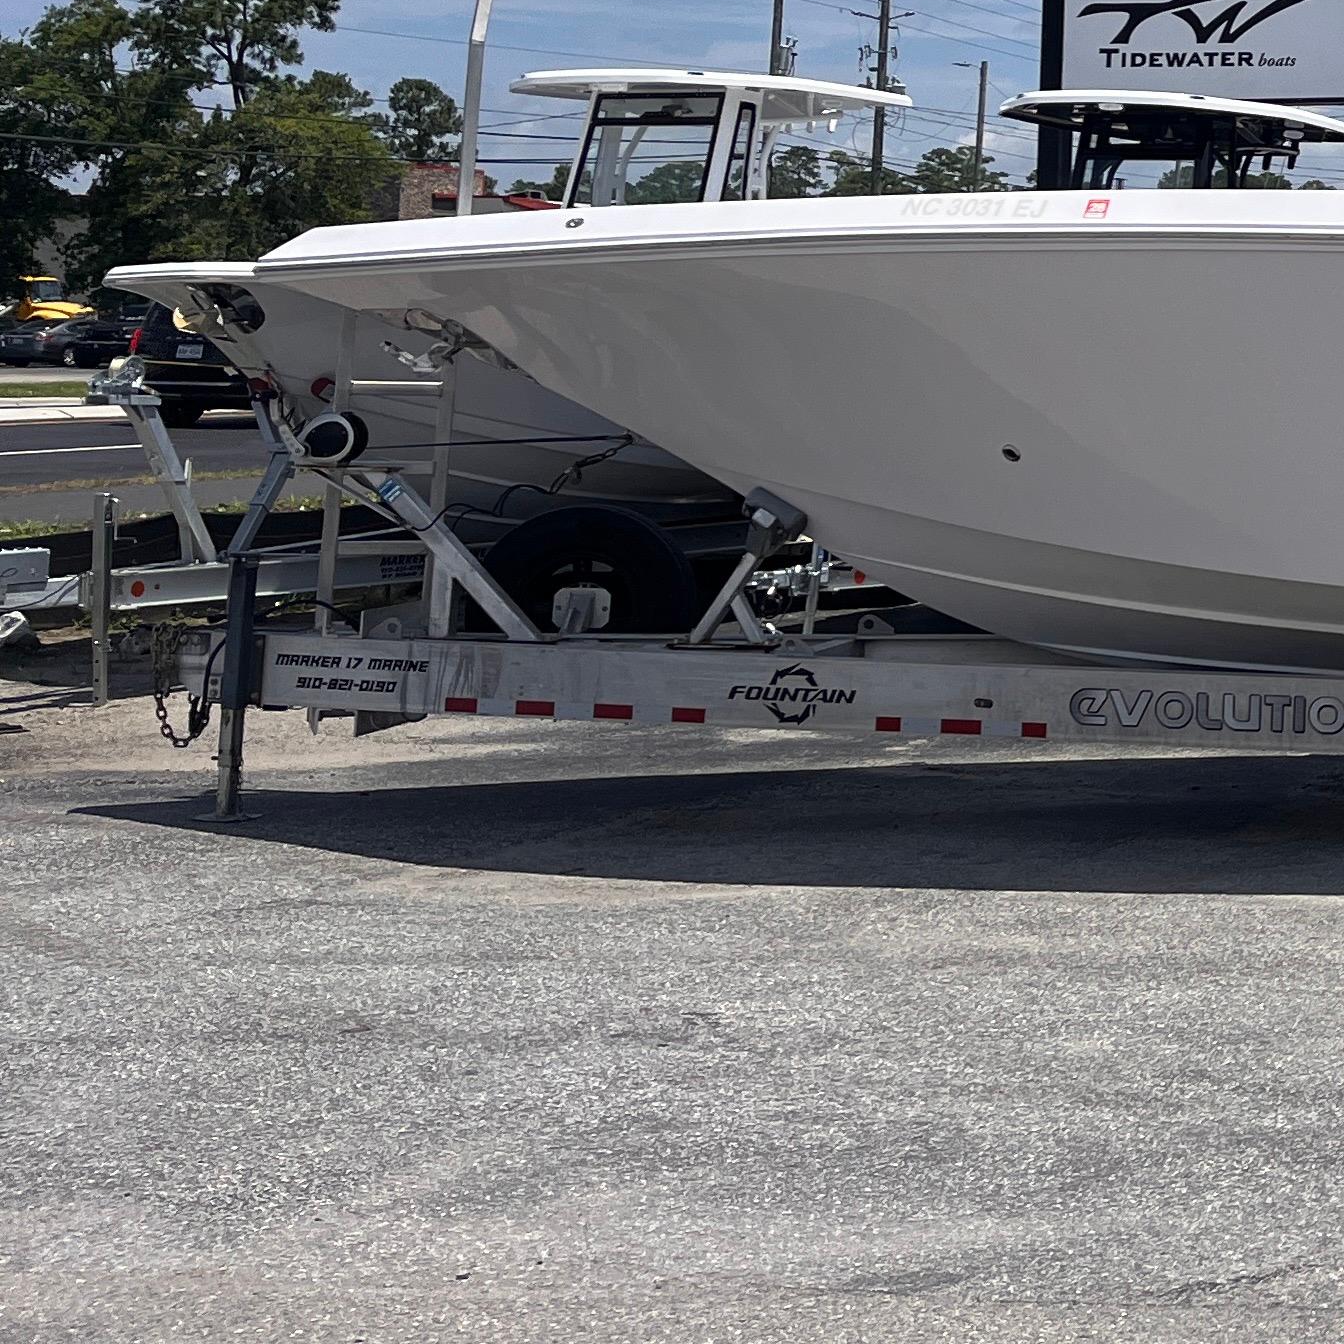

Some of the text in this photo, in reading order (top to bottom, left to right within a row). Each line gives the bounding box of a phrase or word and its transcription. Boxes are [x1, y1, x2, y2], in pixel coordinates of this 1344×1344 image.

[1257, 52, 1297, 68] boats
[901, 198, 1049, 218] NC 3031 EJ
[275, 654, 430, 673] MARKER 17 MARINE
[296, 677, 397, 693] 910-821-0190
[727, 685, 857, 704] FOUNTAIN
